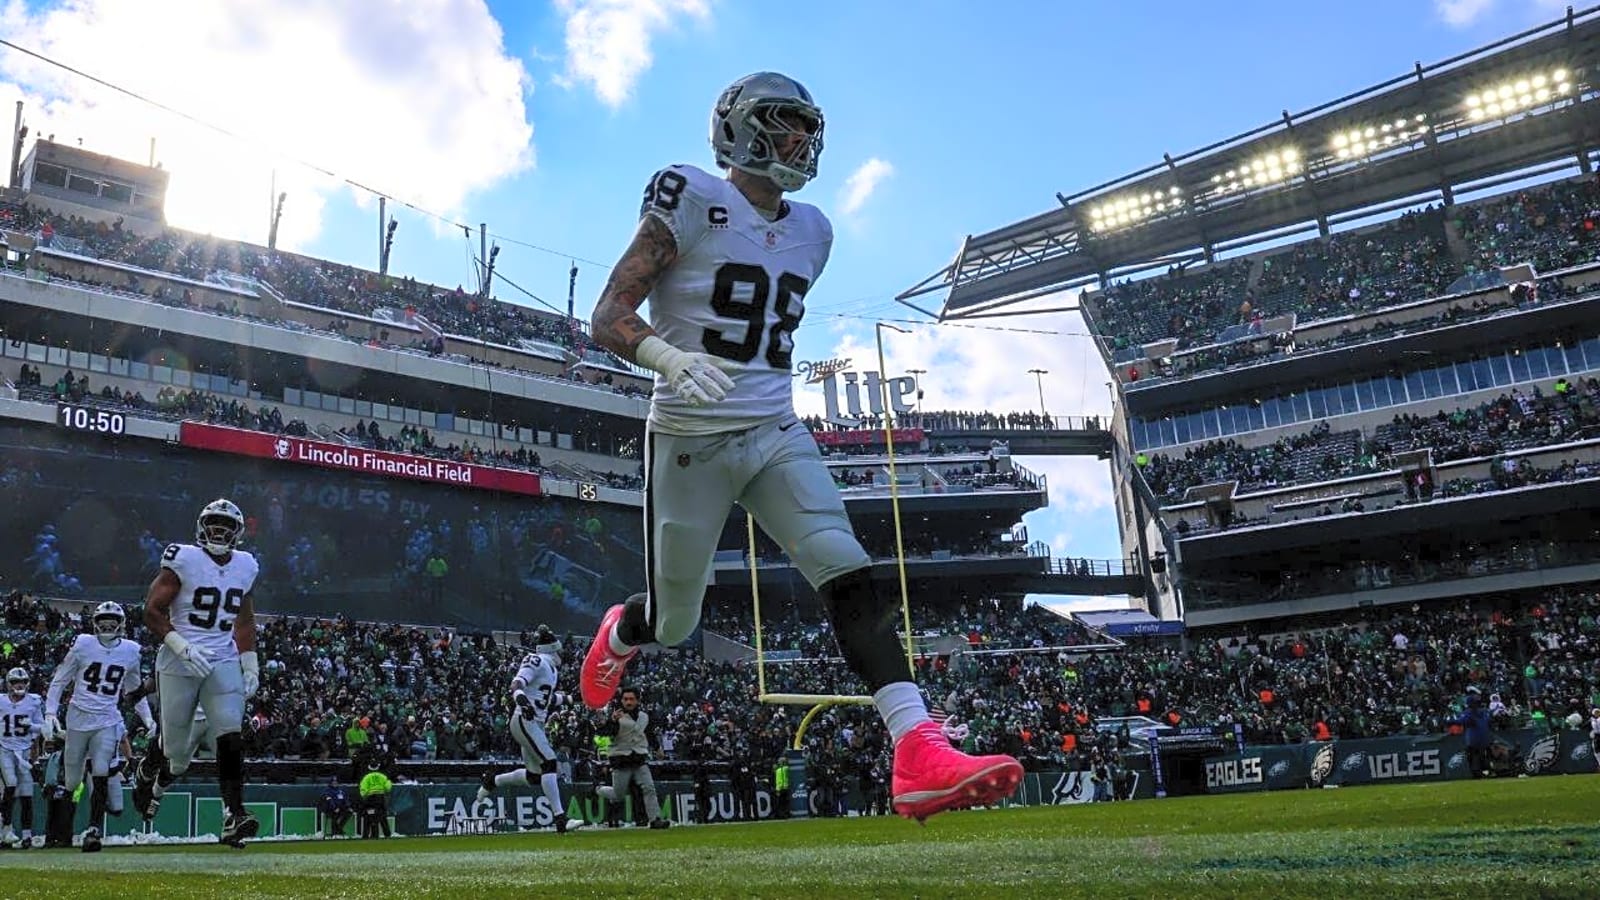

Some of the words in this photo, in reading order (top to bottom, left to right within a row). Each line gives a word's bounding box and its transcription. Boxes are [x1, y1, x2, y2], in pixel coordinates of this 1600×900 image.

[708, 207, 728, 224] C
[702, 262, 809, 369] 98
[797, 358, 852, 382] Miller
[822, 371, 915, 427] Lite
[62, 406, 124, 434] 10:50
[299, 443, 359, 468] Lincoln
[363, 453, 432, 478] Financial
[436, 464, 471, 483] Field
[582, 484, 596, 499] 25
[188, 587, 244, 631] 99
[84, 662, 125, 696] 49
[3, 714, 32, 737] 15
[1206, 757, 1262, 787] EAGLES
[428, 796, 554, 829] EAGLES
[567, 794, 672, 824] AUIM
